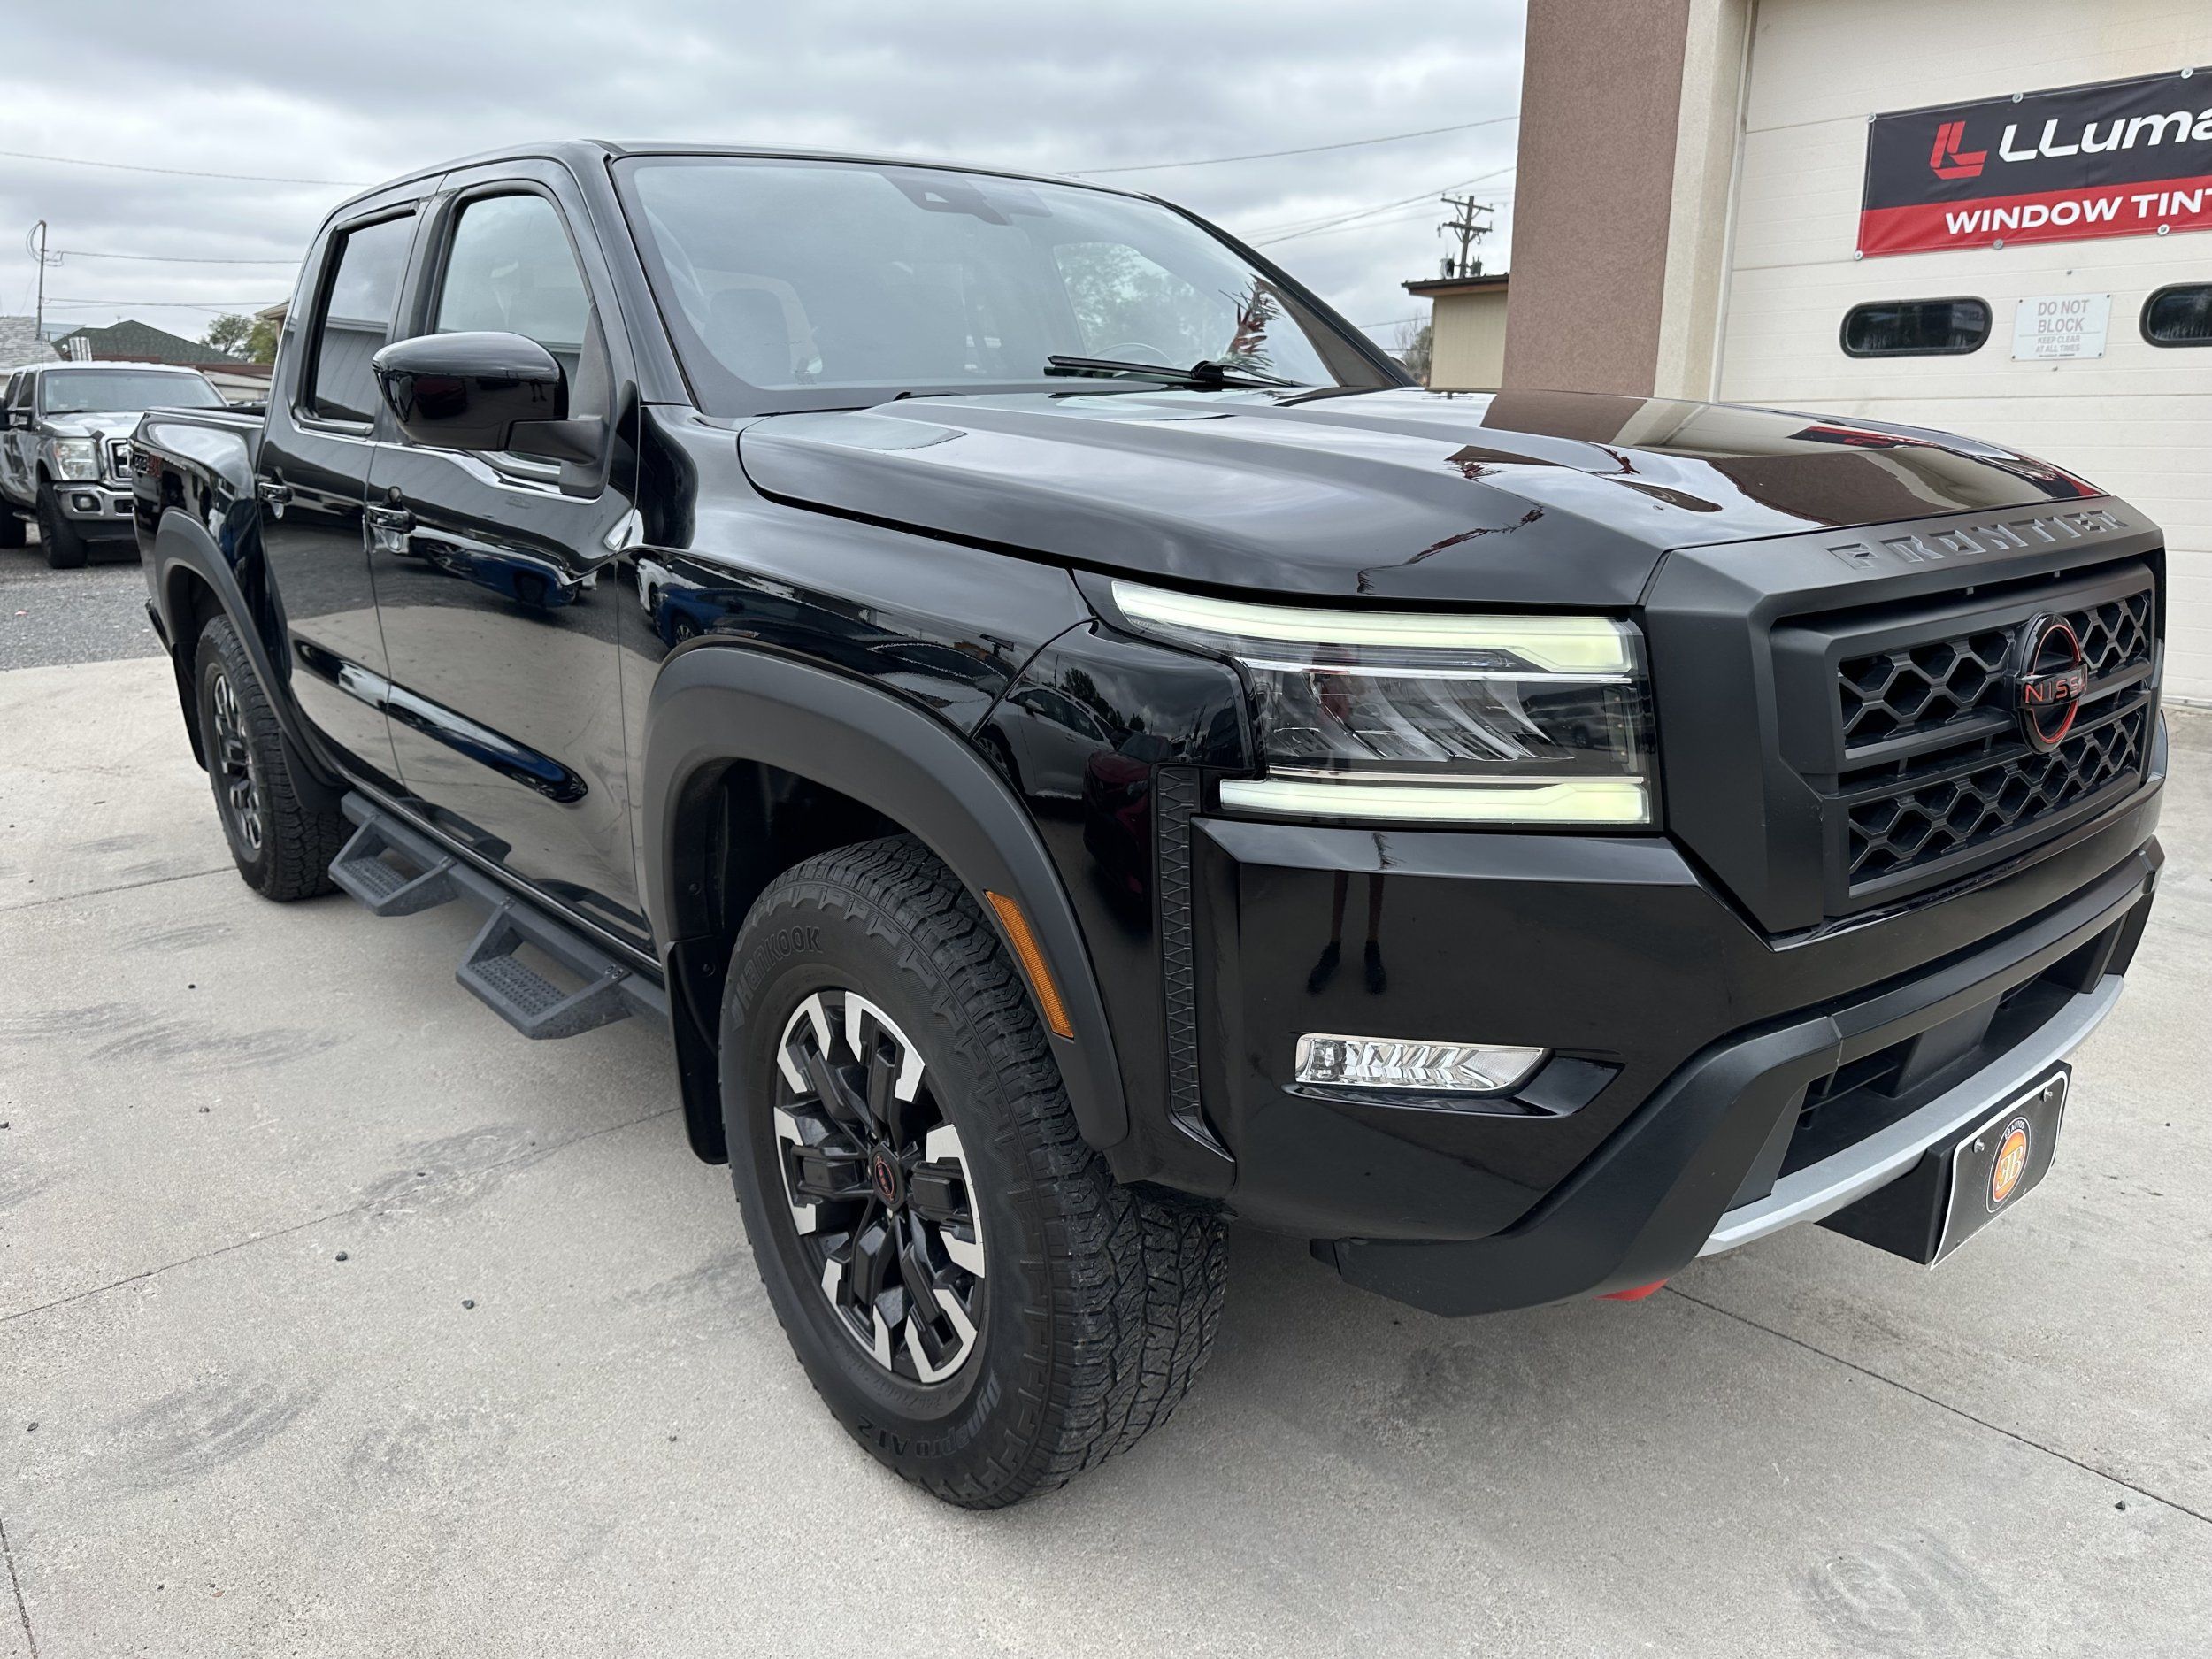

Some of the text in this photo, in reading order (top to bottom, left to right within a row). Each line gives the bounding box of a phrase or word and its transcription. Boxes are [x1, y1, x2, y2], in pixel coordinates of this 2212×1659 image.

[1946, 188, 2212, 234] WINDOW TIN
[2038, 299, 2090, 316] DO NOT
[2038, 317, 2085, 333] BLOCK
[1826, 509, 2131, 571] FRONTIER
[2024, 672, 2085, 703] NISS
